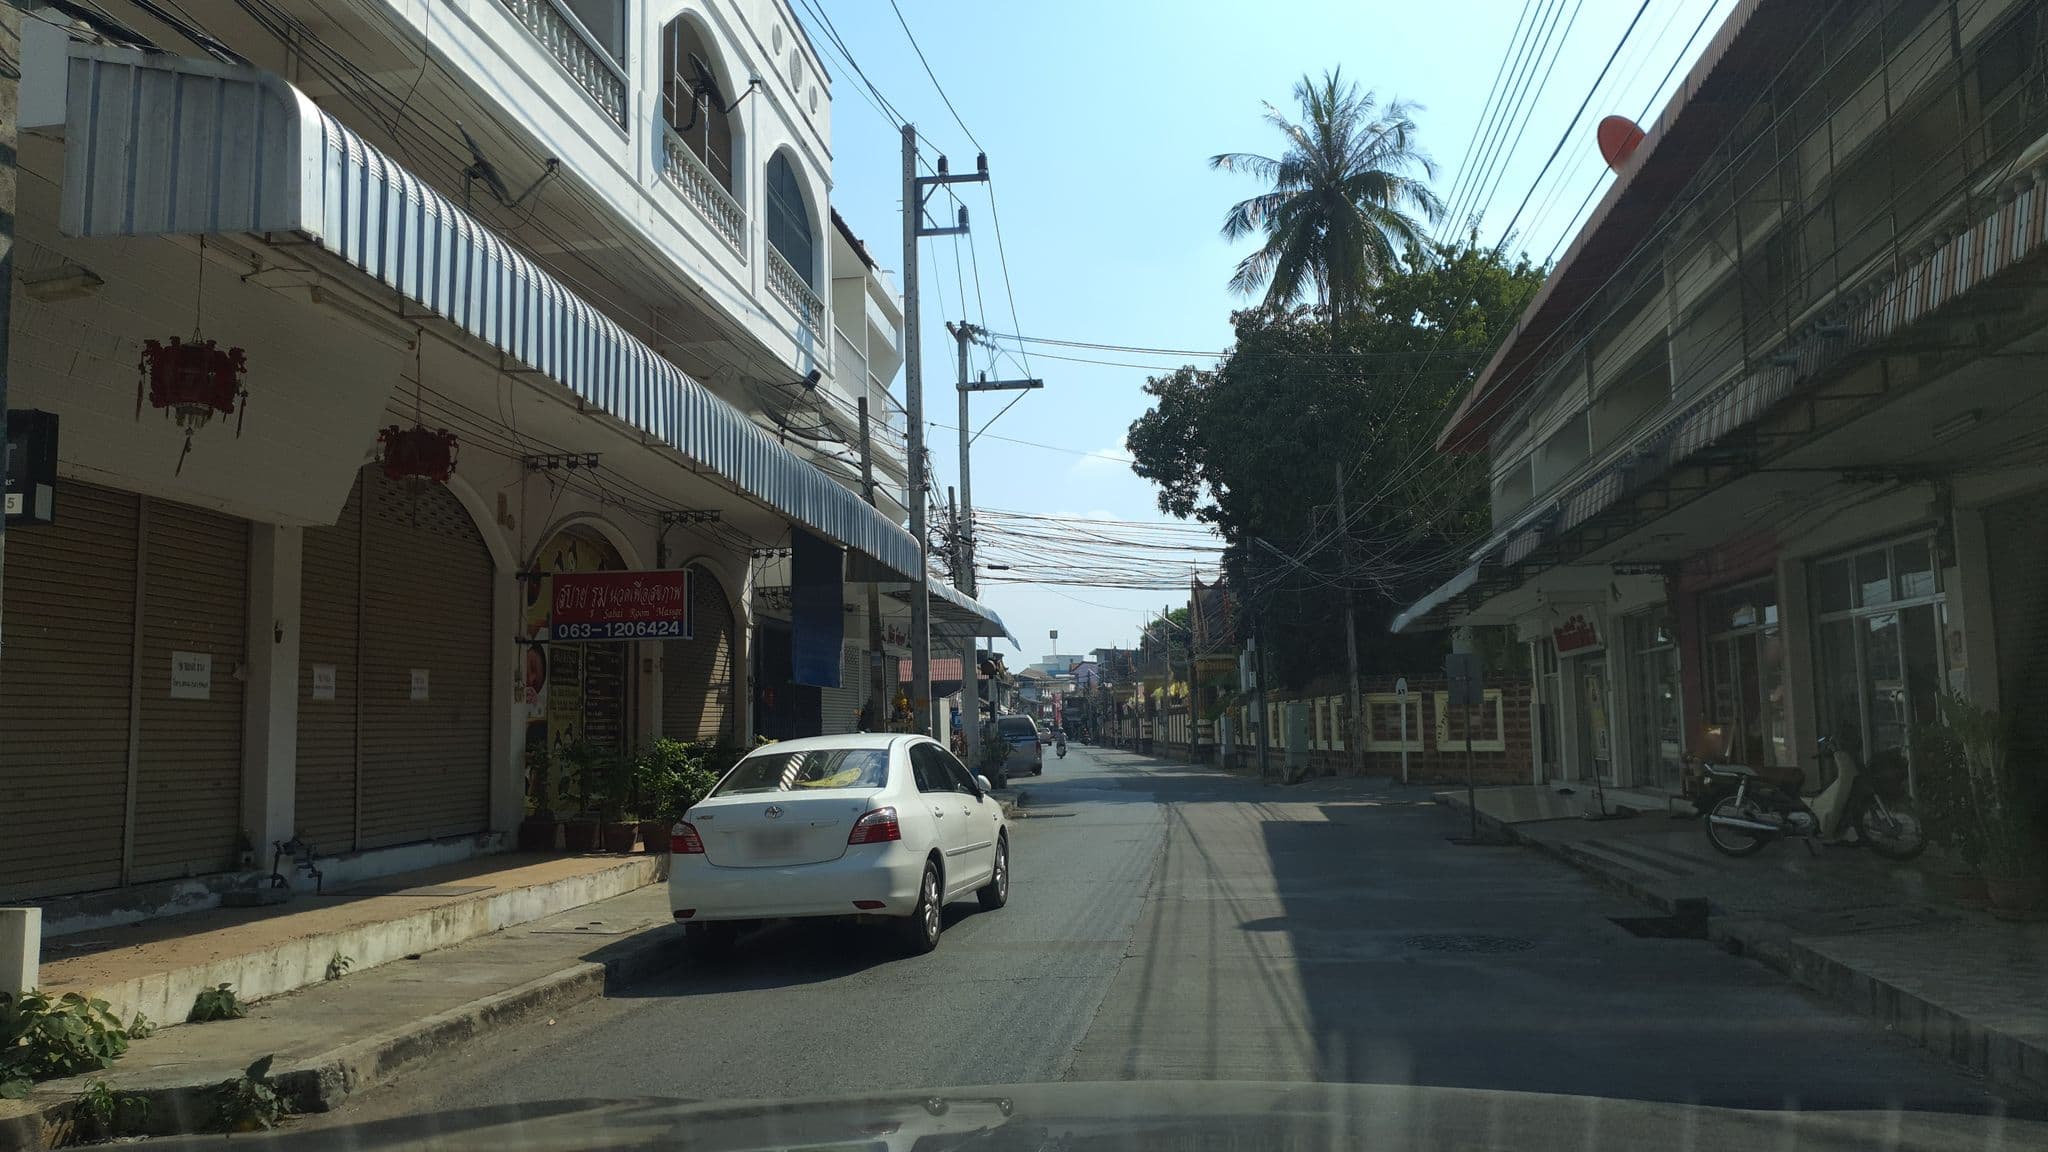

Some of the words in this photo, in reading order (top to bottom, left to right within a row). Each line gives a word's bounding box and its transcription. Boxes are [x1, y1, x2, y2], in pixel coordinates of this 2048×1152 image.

[556, 584, 588, 614] สบาย
[630, 607, 650, 620] Room
[558, 620, 680, 638] 063-1206424
